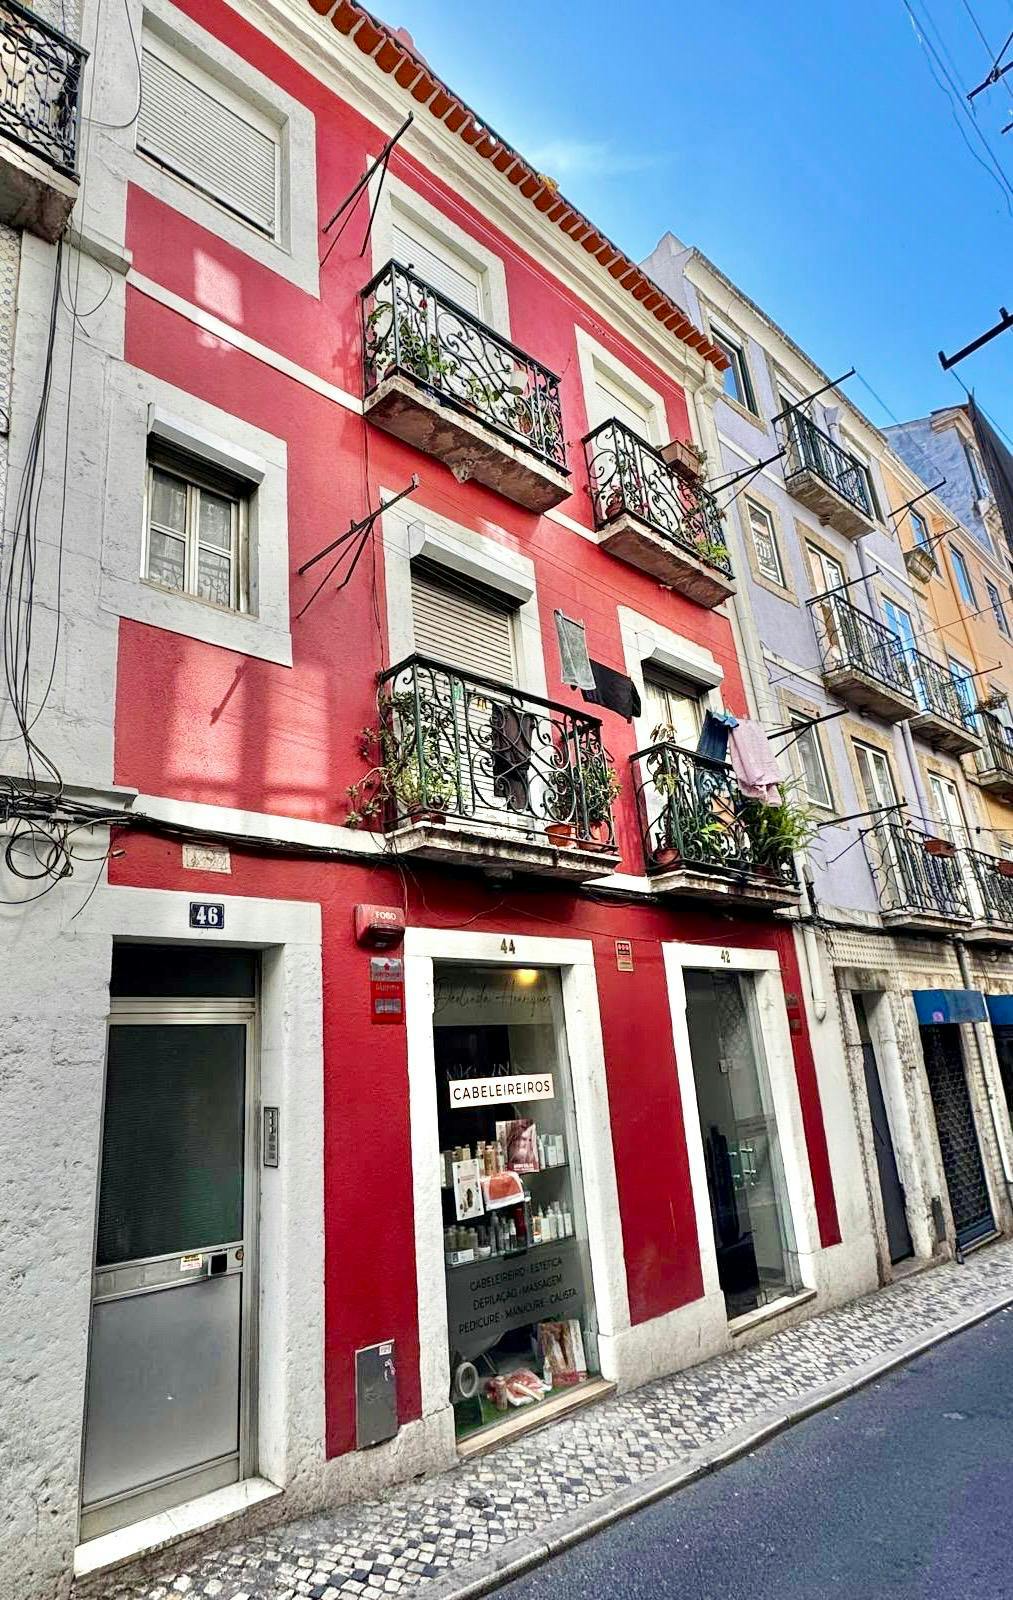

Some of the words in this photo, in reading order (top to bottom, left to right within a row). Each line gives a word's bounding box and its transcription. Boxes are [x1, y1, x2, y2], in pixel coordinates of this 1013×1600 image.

[197, 905, 218, 925] 46
[500, 938, 516, 954] 44
[720, 949, 731, 964] 42
[453, 1080, 550, 1100] CABELEIREIROS
[470, 1267, 525, 1291] CABELEIREIRO
[473, 1289, 518, 1310] DEPILAÇÃO
[523, 1274, 562, 1294] MASSAGEM
[459, 1313, 500, 1334] PEDICURE
[505, 1300, 544, 1318] MANICURE
[550, 1288, 577, 1305] CALISTA
